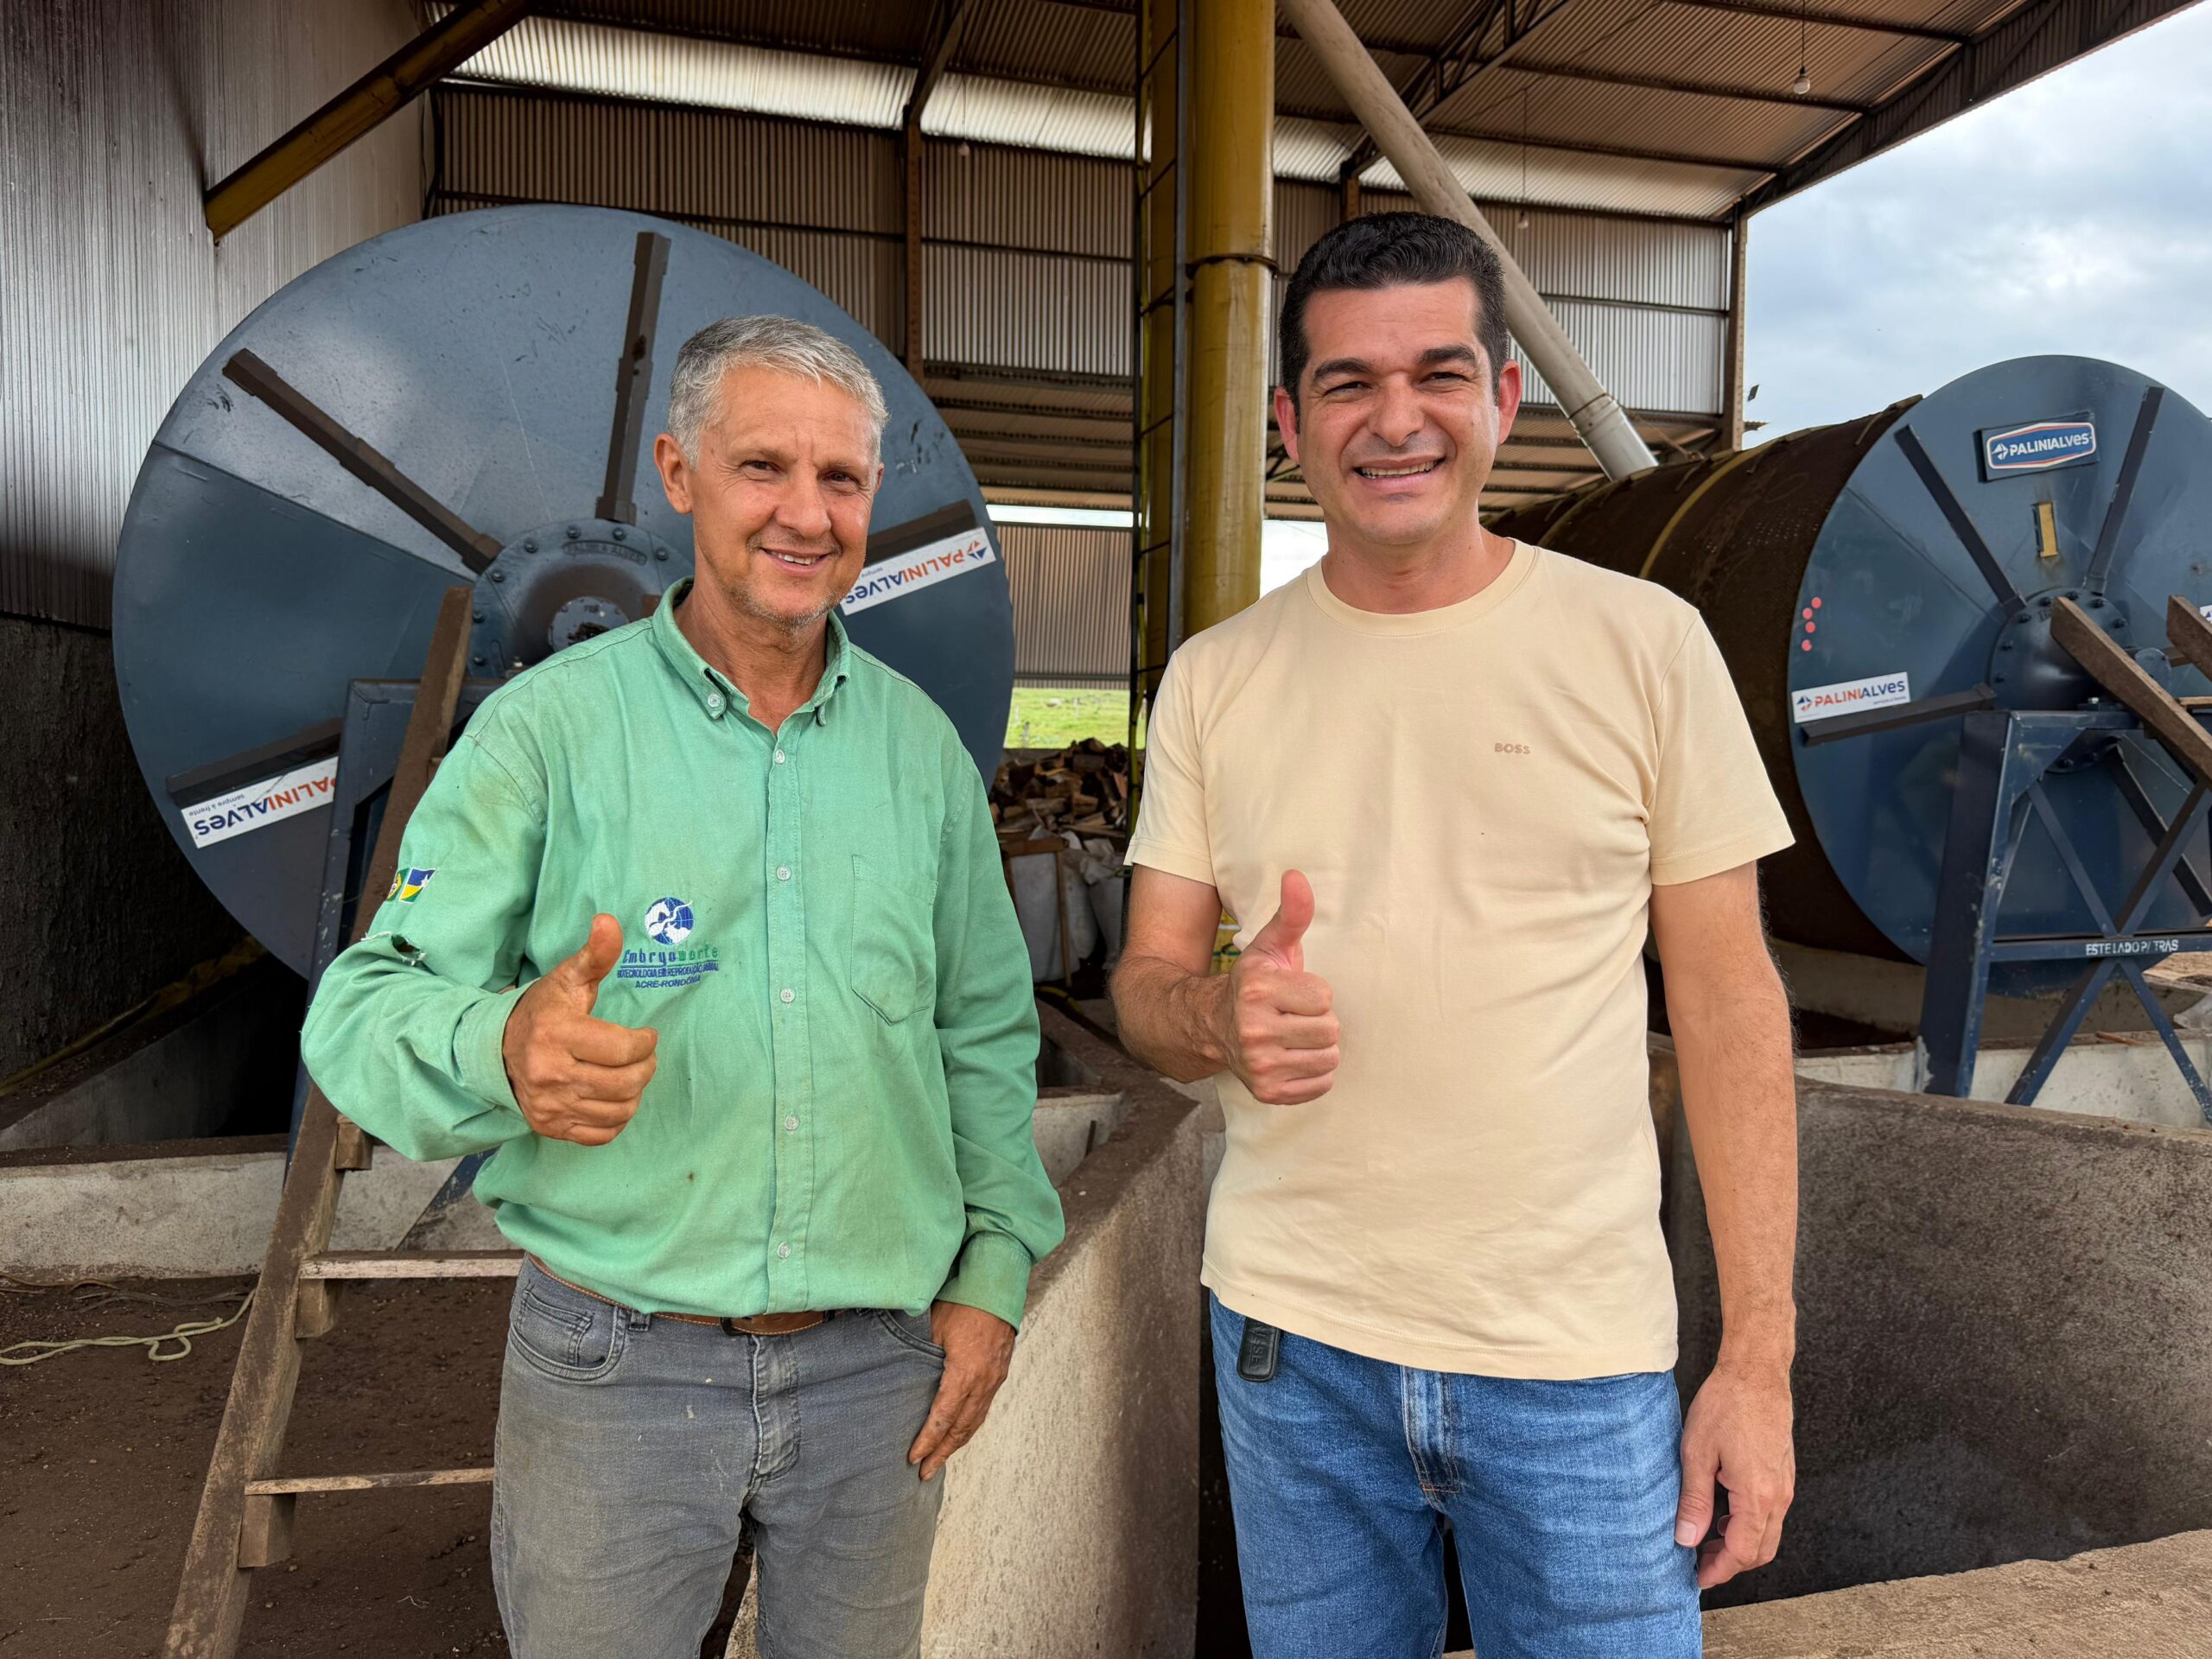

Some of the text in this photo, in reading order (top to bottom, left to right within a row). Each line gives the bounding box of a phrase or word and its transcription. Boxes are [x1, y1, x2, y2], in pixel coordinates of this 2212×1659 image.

[1494, 742, 1531, 754] BOSS
[2085, 939, 2179, 956] ESTE LADO P/ TRAS
